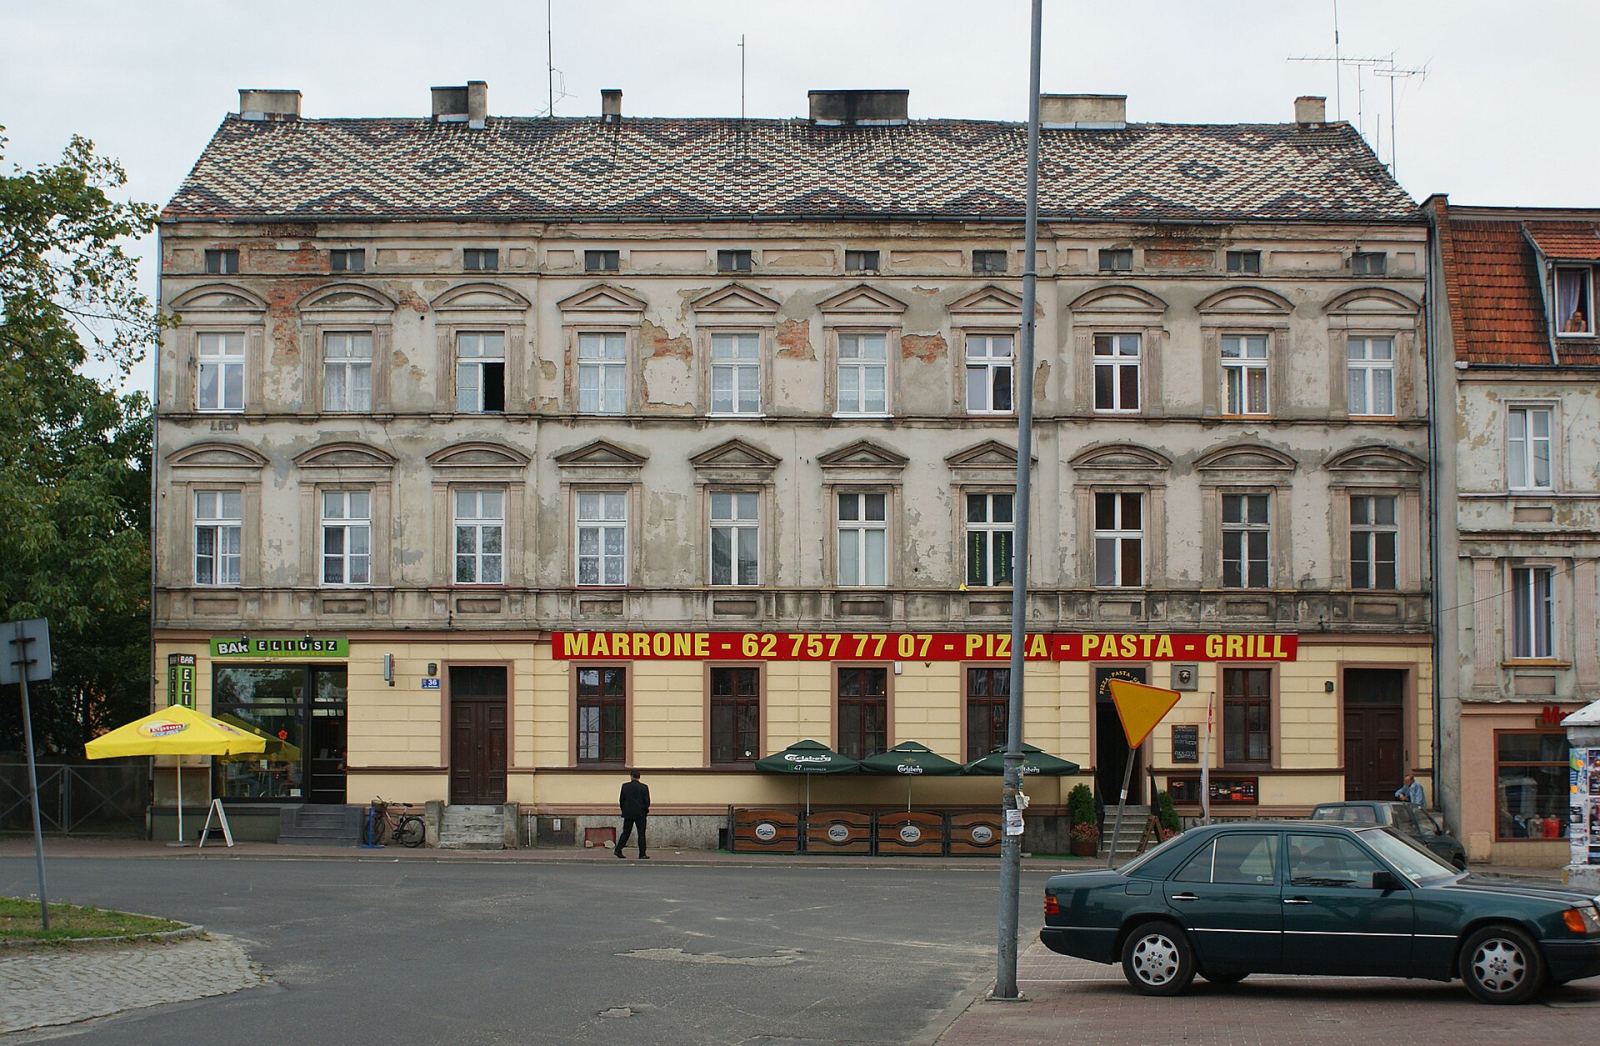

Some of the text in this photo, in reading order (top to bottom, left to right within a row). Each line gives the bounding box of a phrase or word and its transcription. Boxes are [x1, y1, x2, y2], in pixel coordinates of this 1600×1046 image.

[258, 641, 336, 651] ELIUSZ
[563, 633, 710, 657] MARRONE
[742, 633, 777, 657] 62
[788, 633, 843, 657] 757
[850, 633, 888, 657] 77
[897, 633, 933, 657] 07
[965, 633, 1048, 657] PIZA
[1081, 634, 1174, 657] PASTA
[1205, 633, 1288, 658] GRILL
[180, 655, 194, 664] BAR
[784, 753, 832, 763] Carlsberg
[897, 764, 923, 774] Carlsberg
